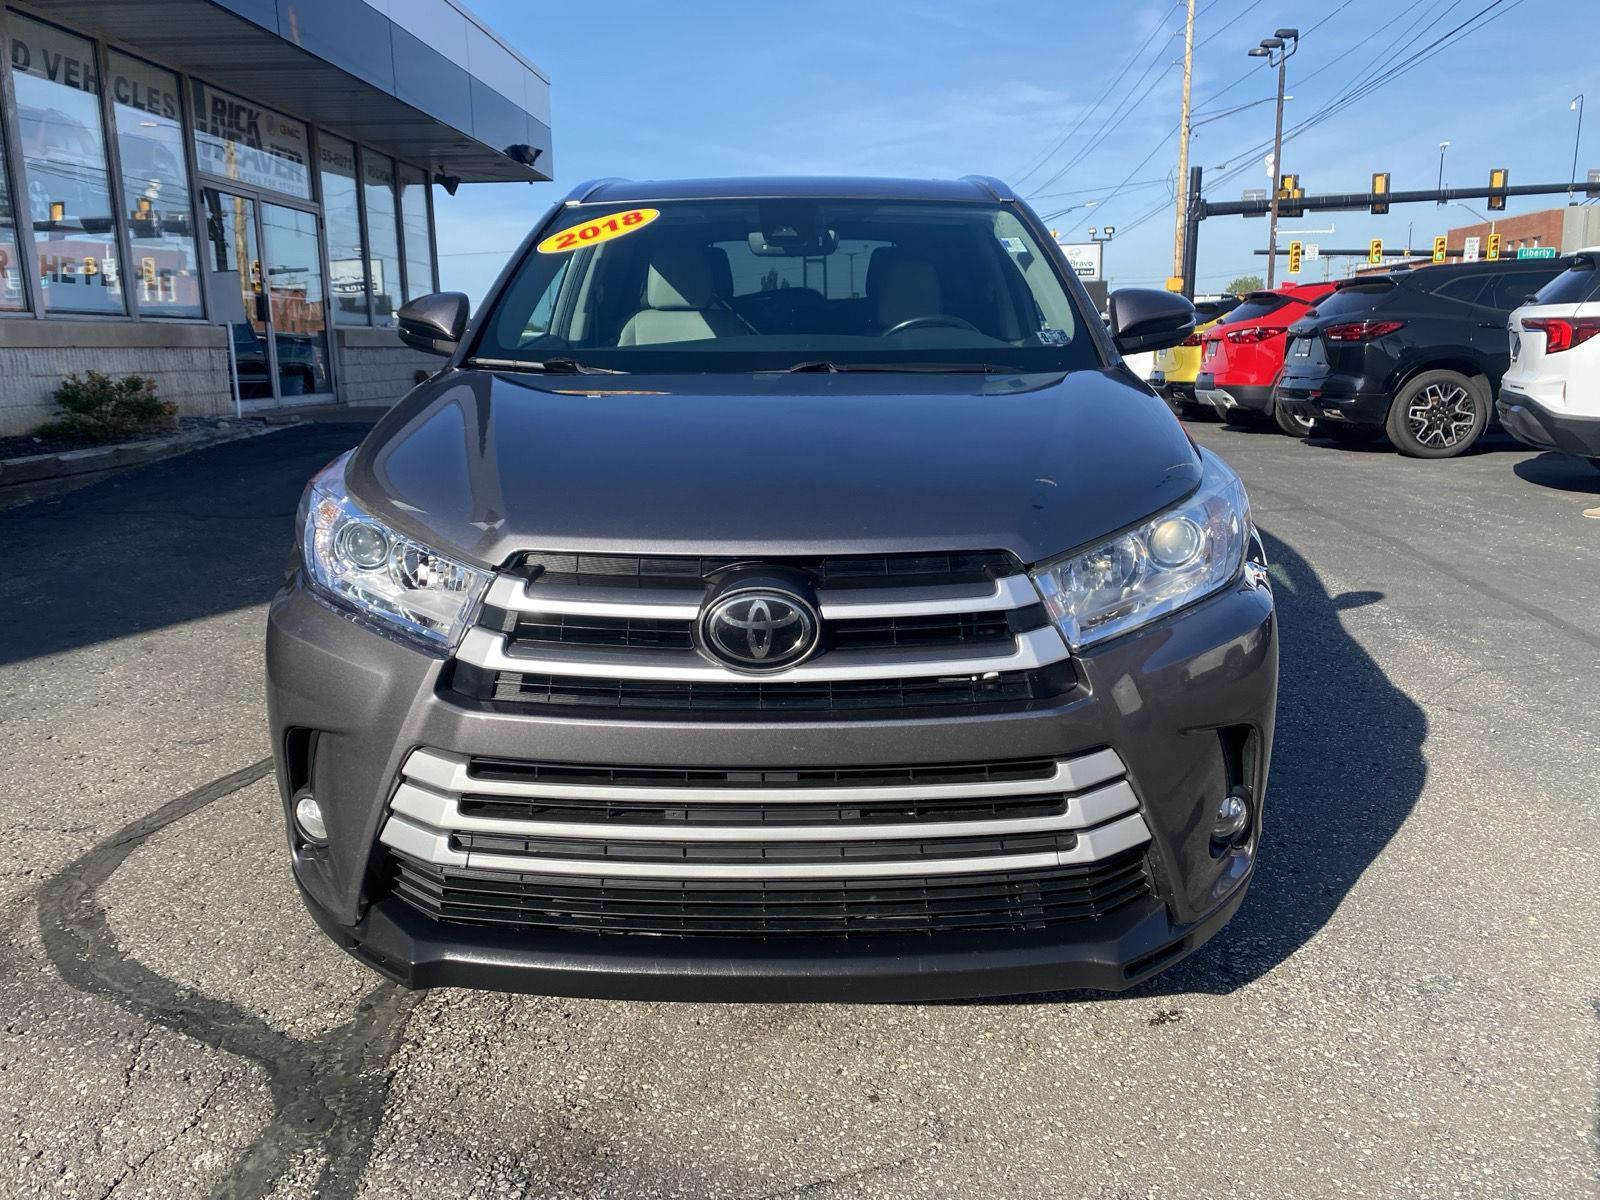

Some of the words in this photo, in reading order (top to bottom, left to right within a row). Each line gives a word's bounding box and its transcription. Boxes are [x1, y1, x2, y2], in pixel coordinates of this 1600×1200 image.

[42, 49, 176, 120] VEHCLES
[211, 96, 261, 139] RICK
[556, 212, 643, 249] 2018
[1522, 248, 1551, 258] Liberty
